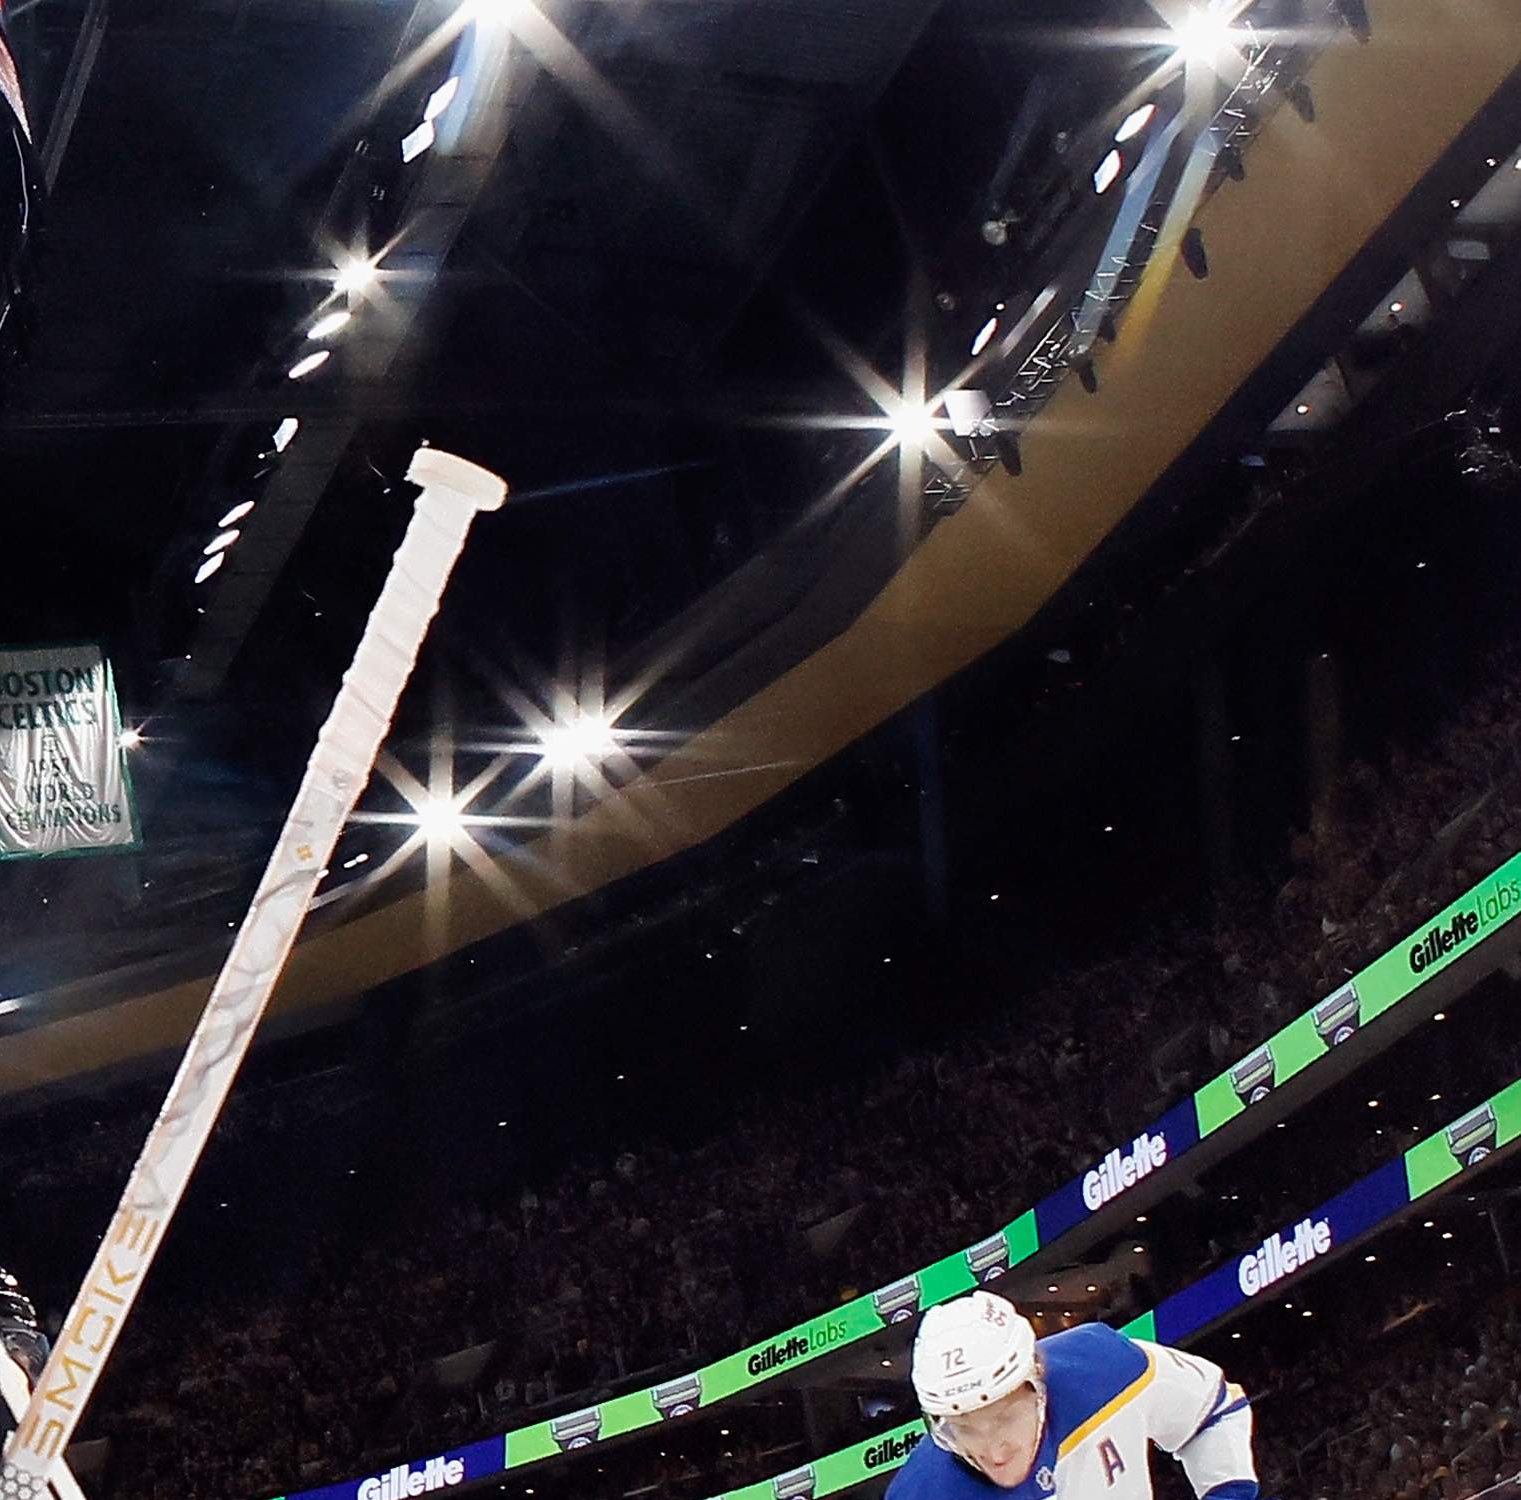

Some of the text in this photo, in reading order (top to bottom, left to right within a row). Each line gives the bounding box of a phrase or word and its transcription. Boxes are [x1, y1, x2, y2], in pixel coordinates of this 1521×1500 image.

[26, 781, 96, 804] WORLD
[4, 802, 122, 833] CHAMPIONS
[1082, 1131, 1166, 1213] Gillette
[1238, 1217, 1332, 1298] Gillette
[941, 1346, 966, 1371] 72
[1095, 1438, 1125, 1489] A
